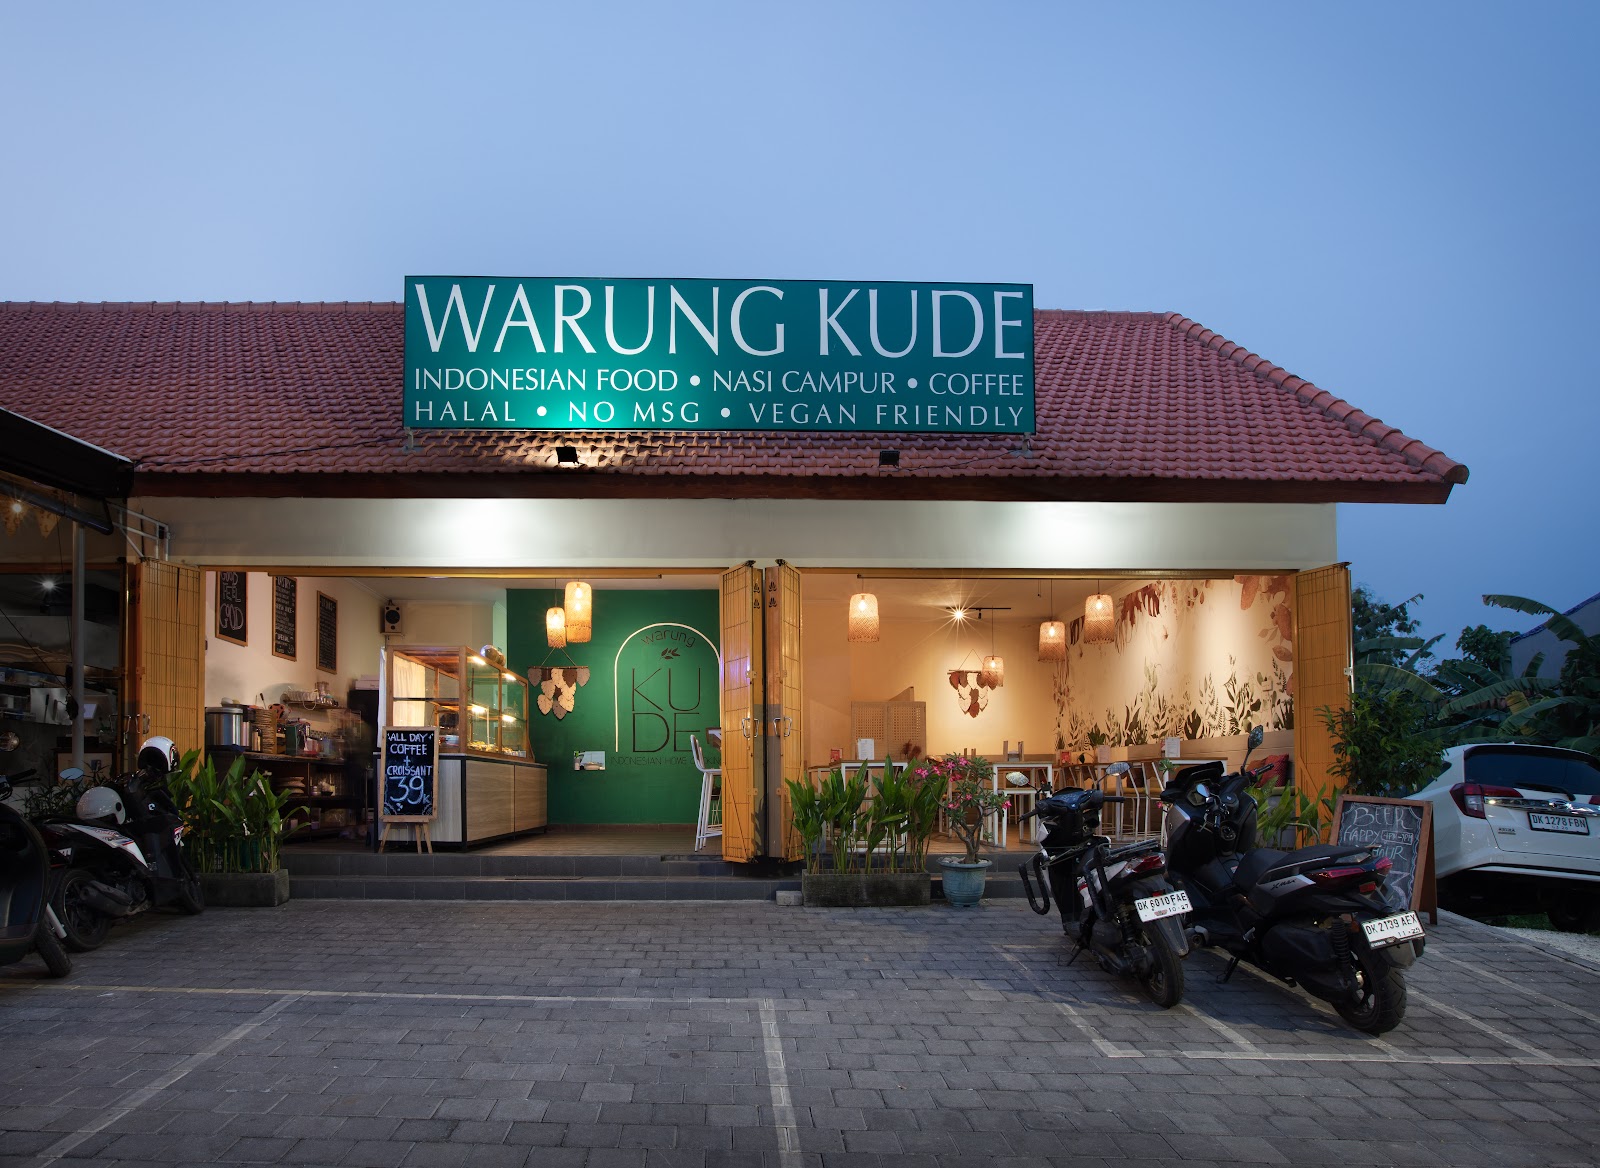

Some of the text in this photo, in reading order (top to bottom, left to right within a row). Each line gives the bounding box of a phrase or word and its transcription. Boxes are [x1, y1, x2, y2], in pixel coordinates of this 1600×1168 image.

[415, 283, 1025, 359] WARUNG KUDE
[415, 367, 1024, 396] INDONESIAN FOOD NASI CAMPUR COFFEE
[415, 401, 1023, 426] HALAL NO MSG VEGAN FRIENDLY
[641, 629, 696, 648] warung
[632, 668, 701, 712] KU
[390, 733, 428, 742] ALL DAY
[632, 712, 701, 752] DE
[390, 744, 427, 755] COFFEE
[387, 765, 432, 776] CROISSANT
[1353, 807, 1413, 829] BEER
[1545, 816, 1567, 826] 1278
[1344, 825, 1380, 846] HAPPY
[1137, 901, 1148, 911] DK
[1365, 914, 1417, 935] DK 2139 AEX
